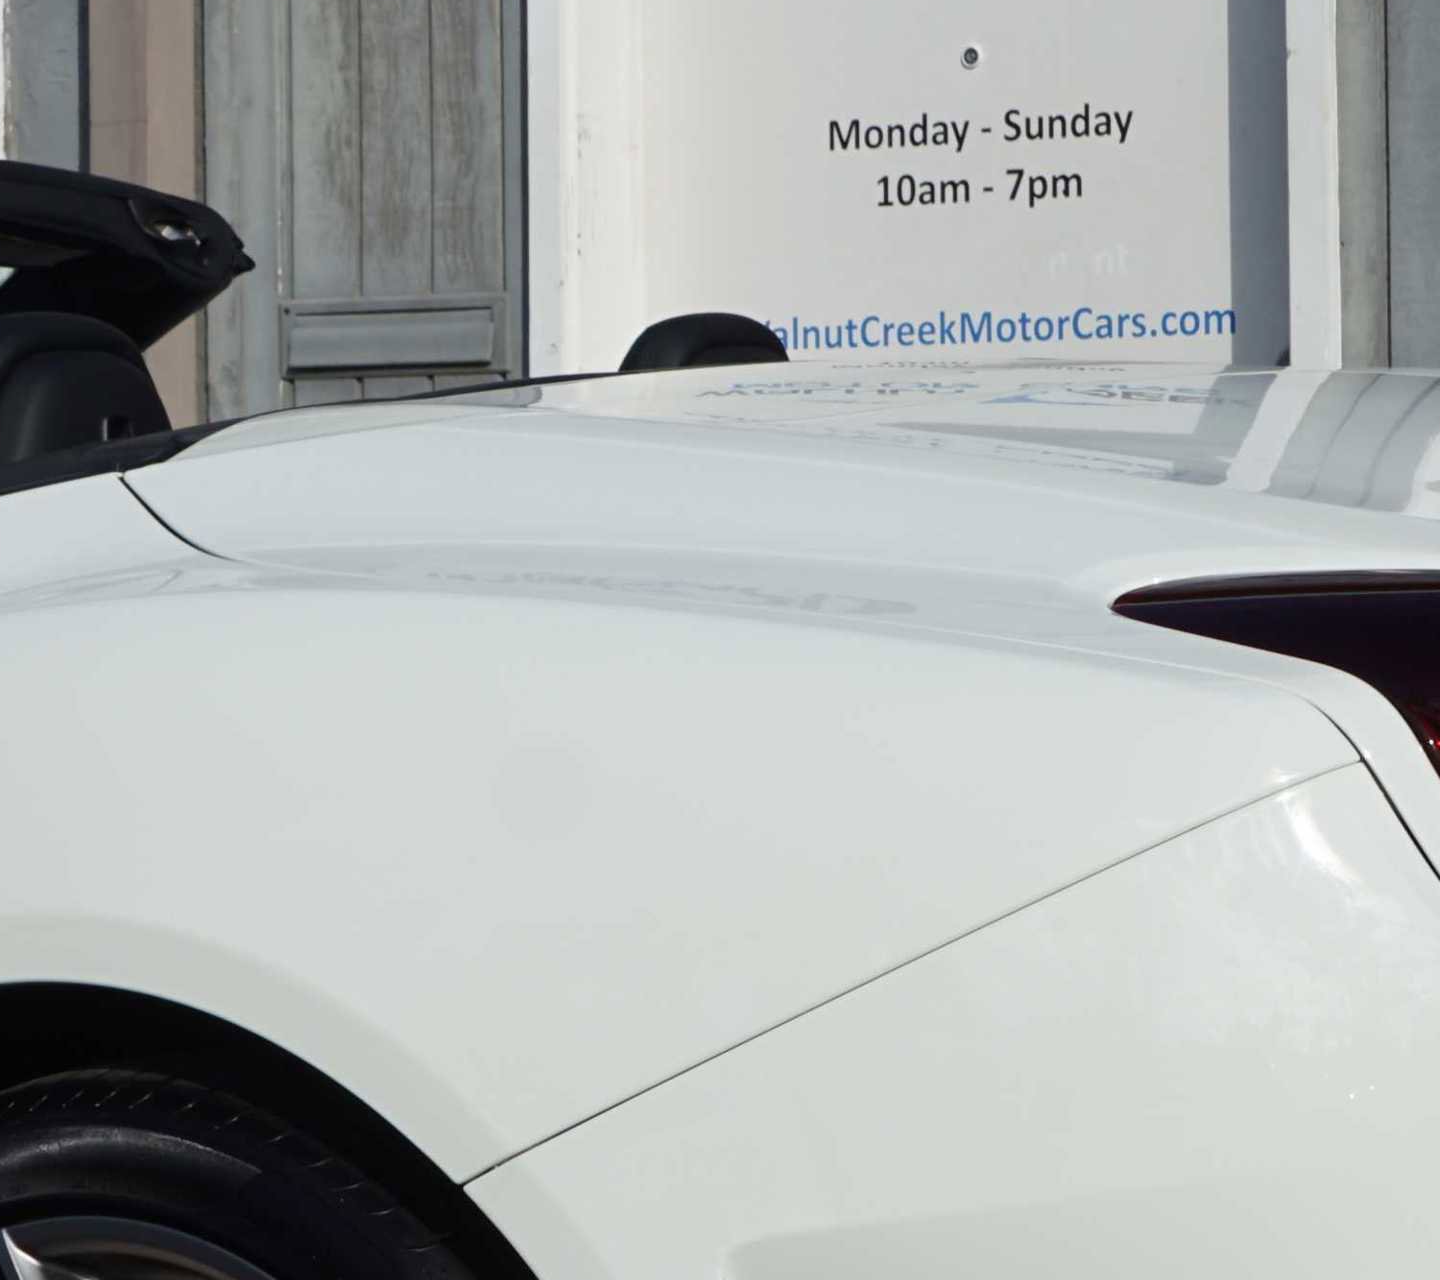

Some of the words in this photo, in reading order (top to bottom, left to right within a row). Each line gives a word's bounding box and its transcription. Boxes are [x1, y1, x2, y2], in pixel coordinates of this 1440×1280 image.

[828, 113, 970, 153] Monday
[1003, 103, 1134, 144] Sunday
[877, 174, 971, 208] 10am
[1005, 169, 1084, 209] 7pm
[765, 306, 1238, 353] alnutCreekMotorCars.com
